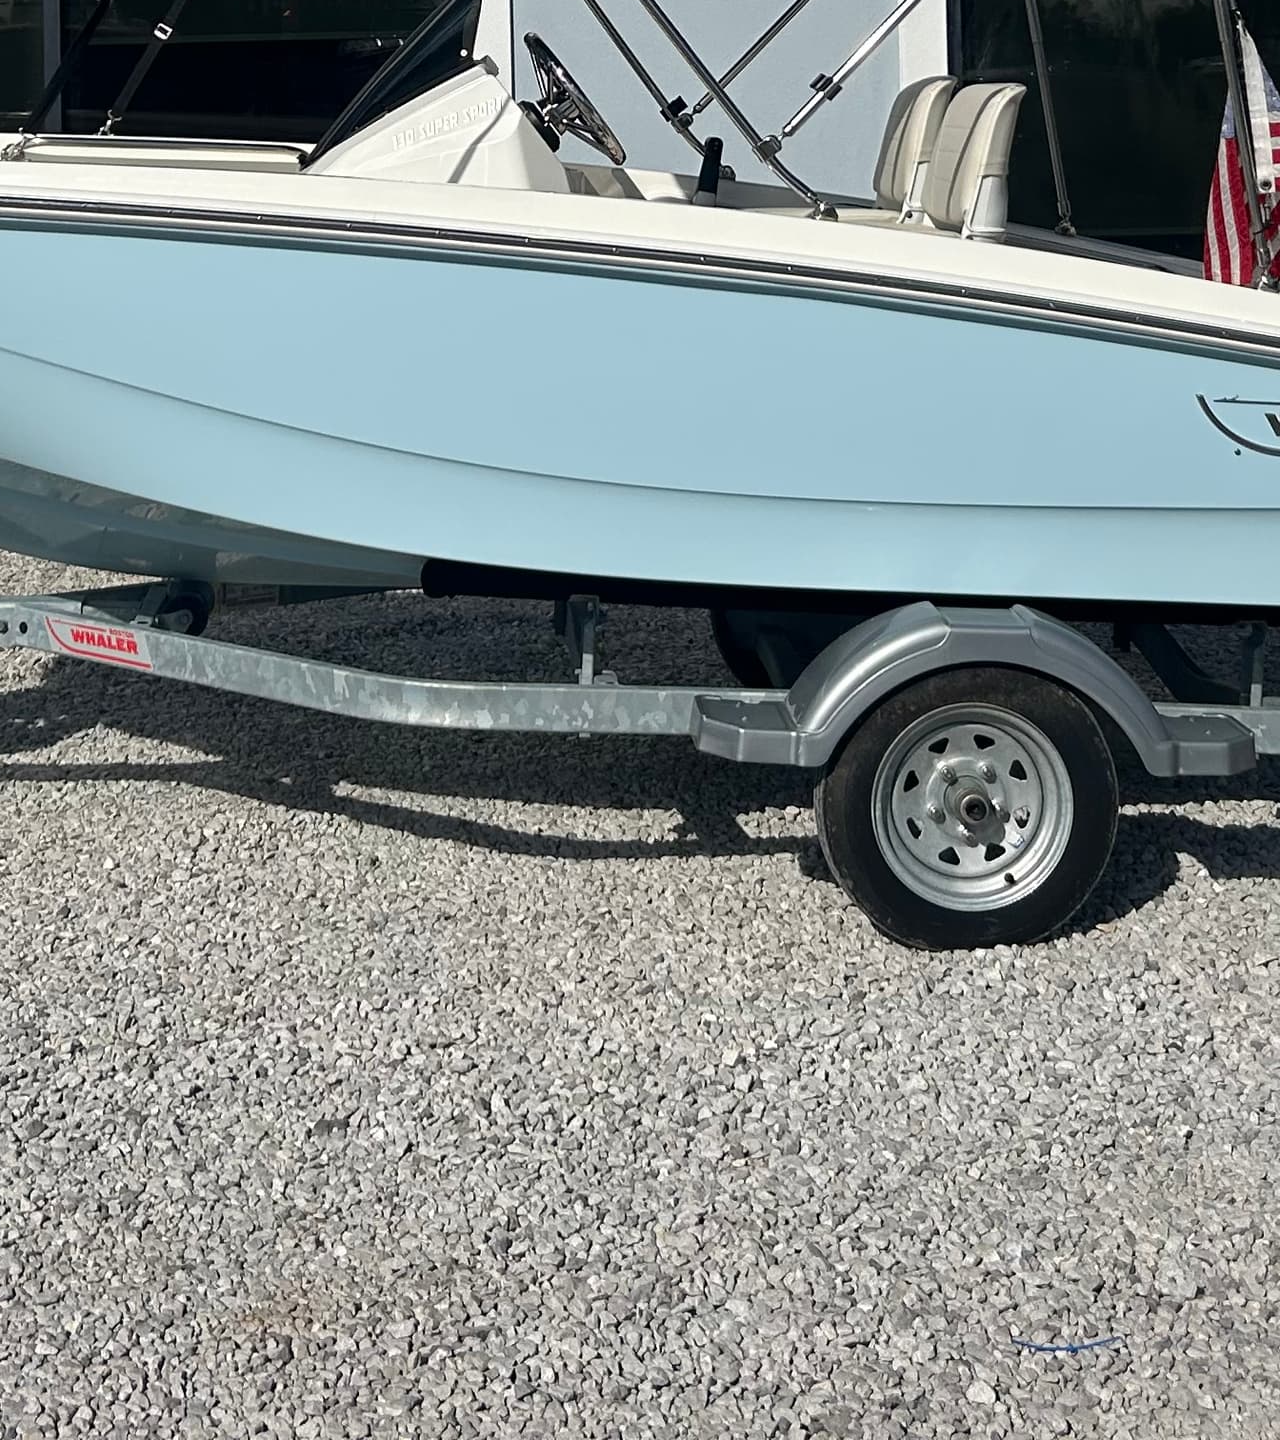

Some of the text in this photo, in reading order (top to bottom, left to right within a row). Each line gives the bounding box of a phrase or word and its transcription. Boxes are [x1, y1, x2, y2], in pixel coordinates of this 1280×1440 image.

[419, 112, 459, 139] SUPER
[462, 96, 505, 123] SPORT
[71, 629, 138, 655] WHALER
